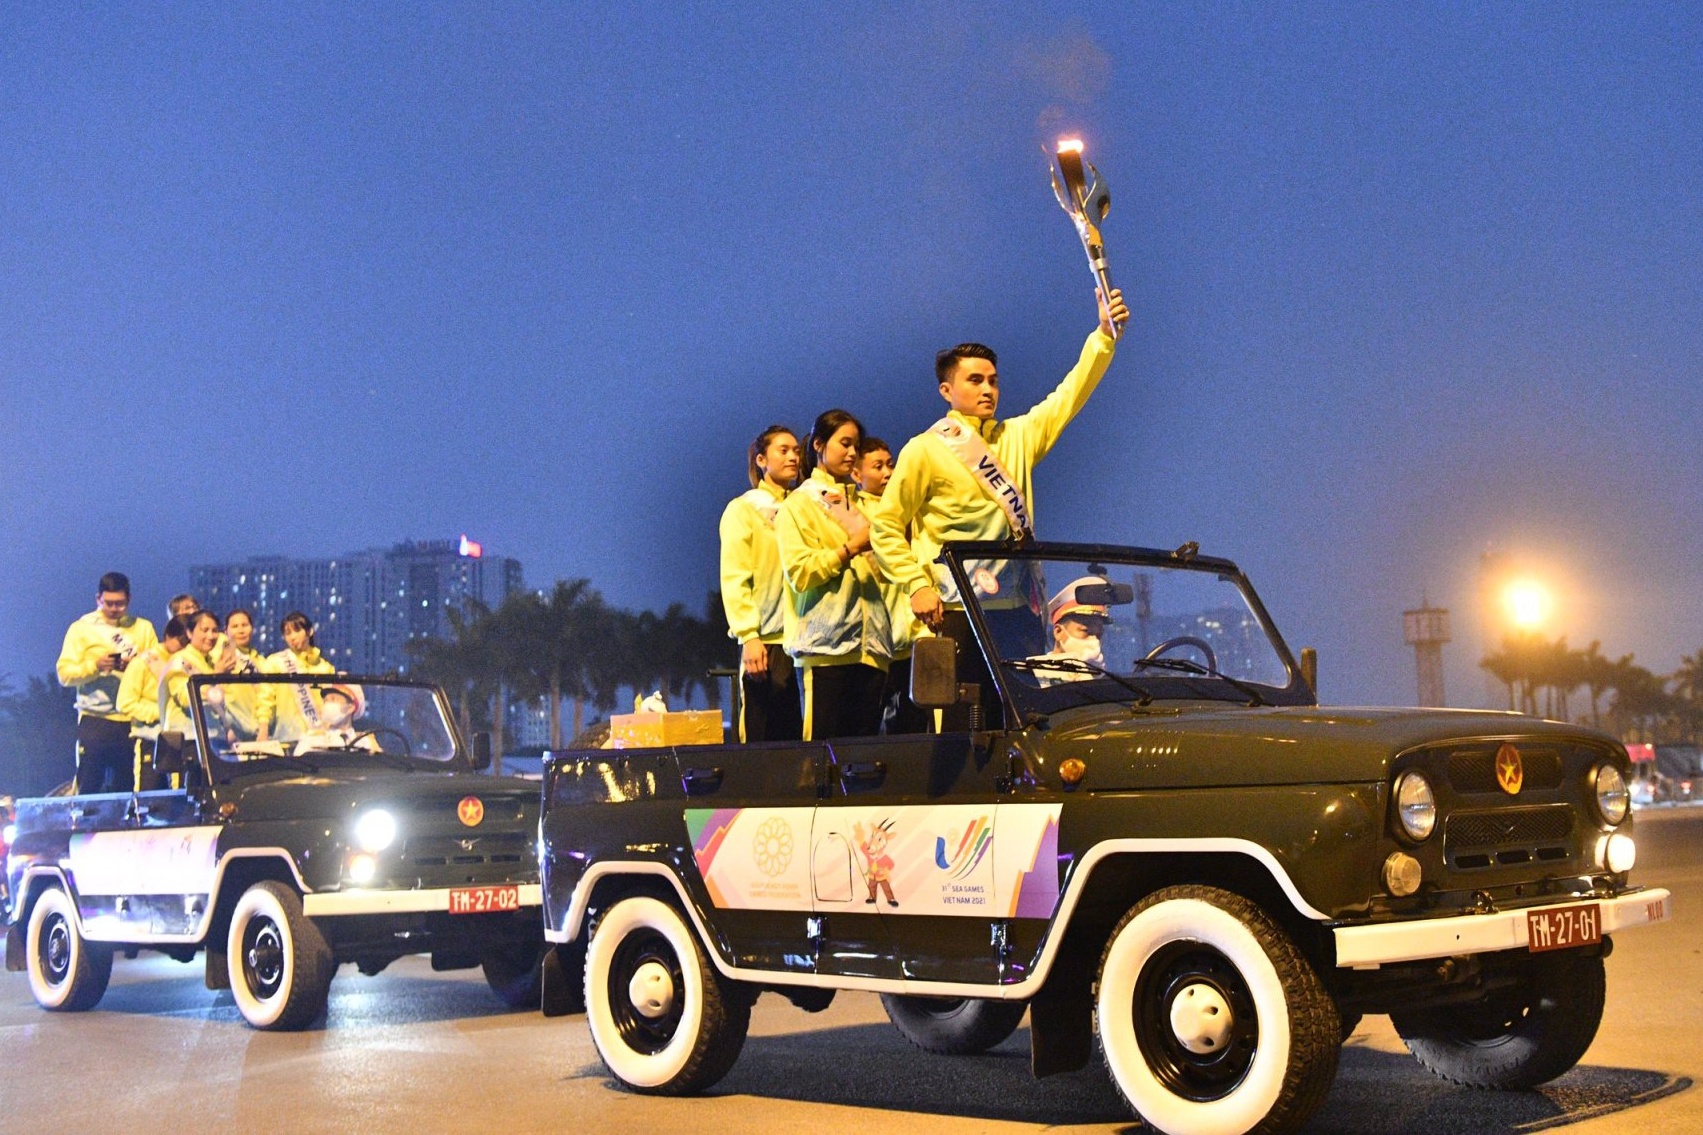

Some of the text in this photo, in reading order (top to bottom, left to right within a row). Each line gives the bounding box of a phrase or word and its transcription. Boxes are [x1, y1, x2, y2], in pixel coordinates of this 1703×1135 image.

[952, 885, 963, 893] SEA
[964, 885, 985, 894] GAMES
[451, 889, 517, 911] TM-27-02
[943, 896, 986, 905] VIET NAM 2021
[1529, 908, 1597, 948] TM-27-01
